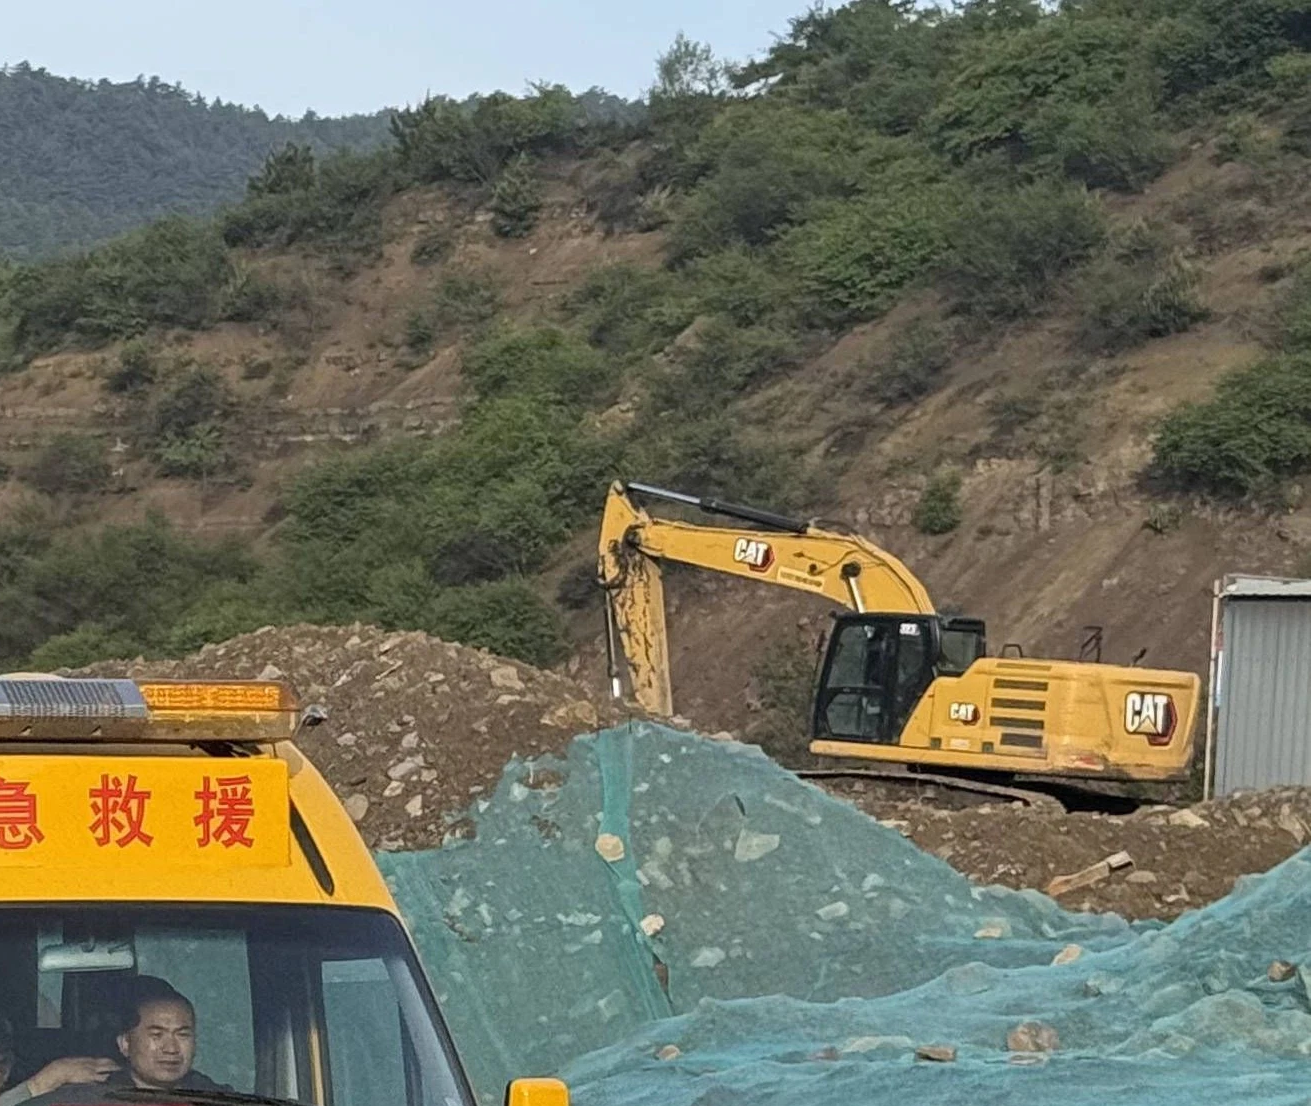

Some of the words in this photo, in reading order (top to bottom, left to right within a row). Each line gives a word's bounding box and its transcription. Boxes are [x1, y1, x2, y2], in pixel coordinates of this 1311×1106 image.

[734, 538, 769, 566] CAT
[950, 703, 976, 721] CAT
[1125, 692, 1168, 734] CAT
